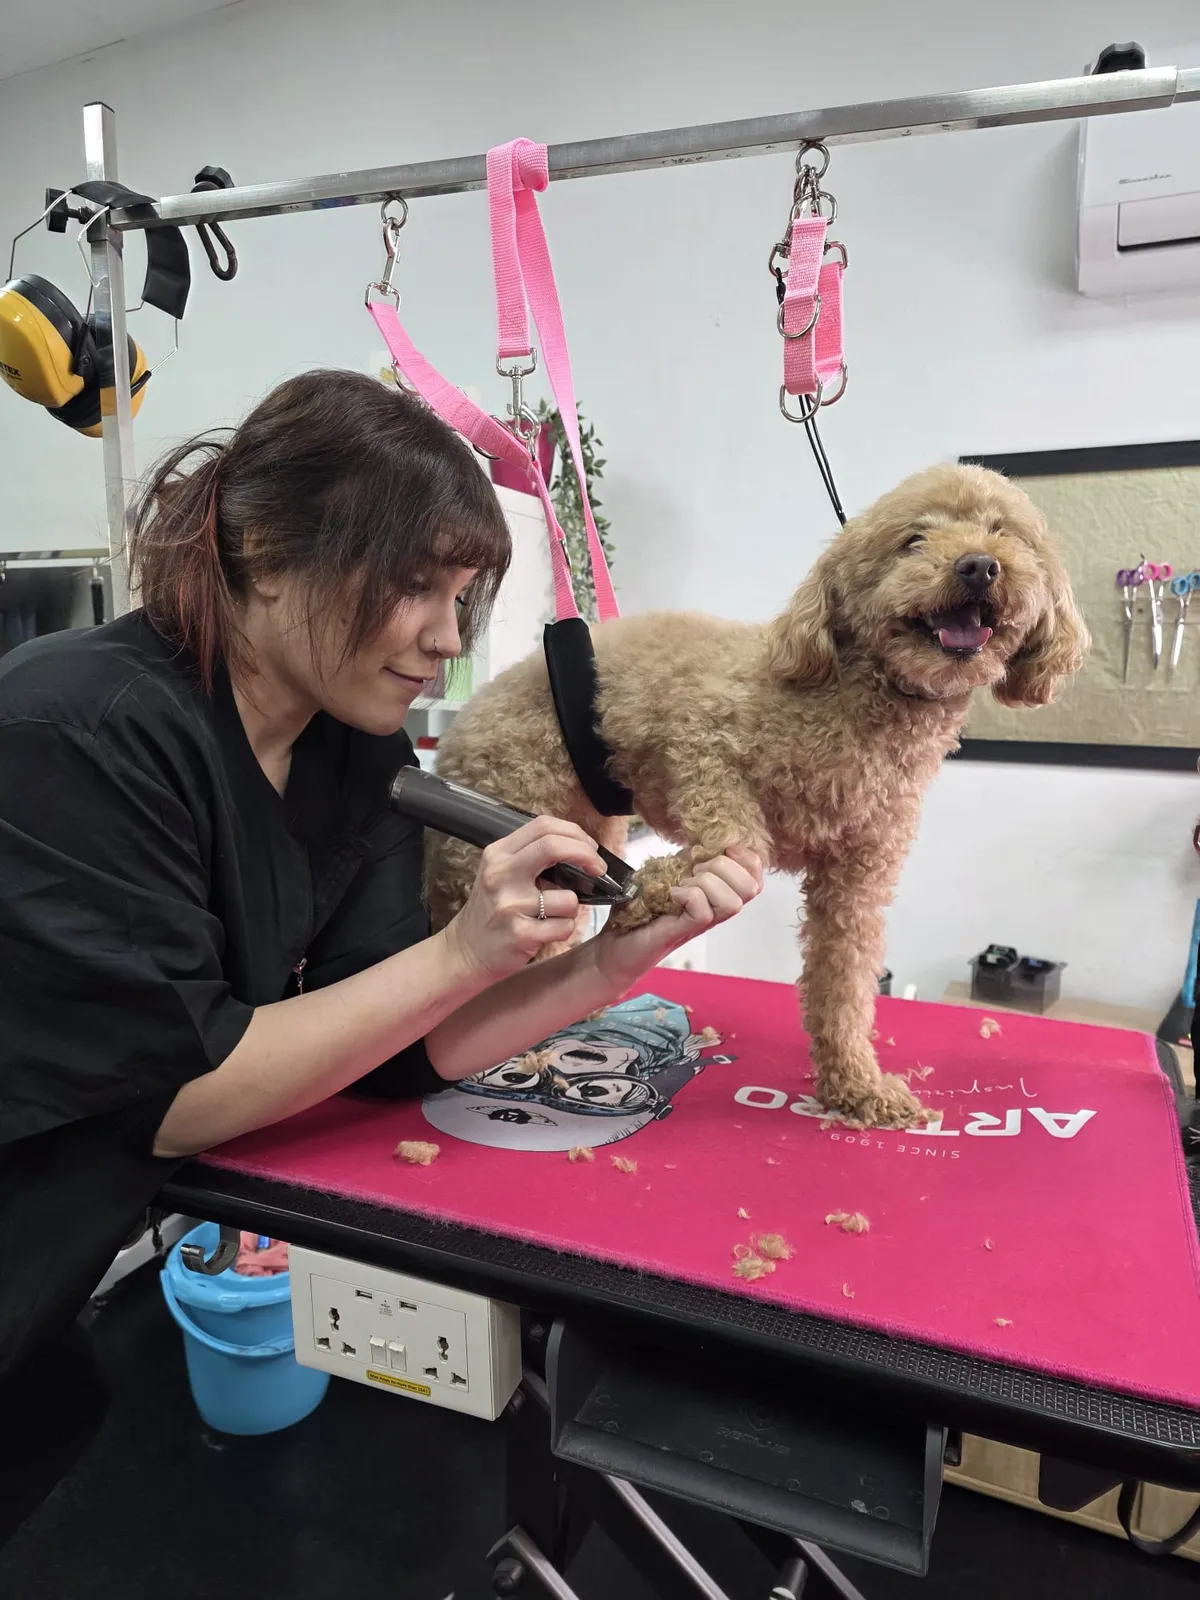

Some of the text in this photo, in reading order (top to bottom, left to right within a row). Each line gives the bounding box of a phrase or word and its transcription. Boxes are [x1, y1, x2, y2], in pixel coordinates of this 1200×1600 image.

[734, 1086, 1097, 1138] ARTRO
[830, 1133, 961, 1159] SINCE 1909
